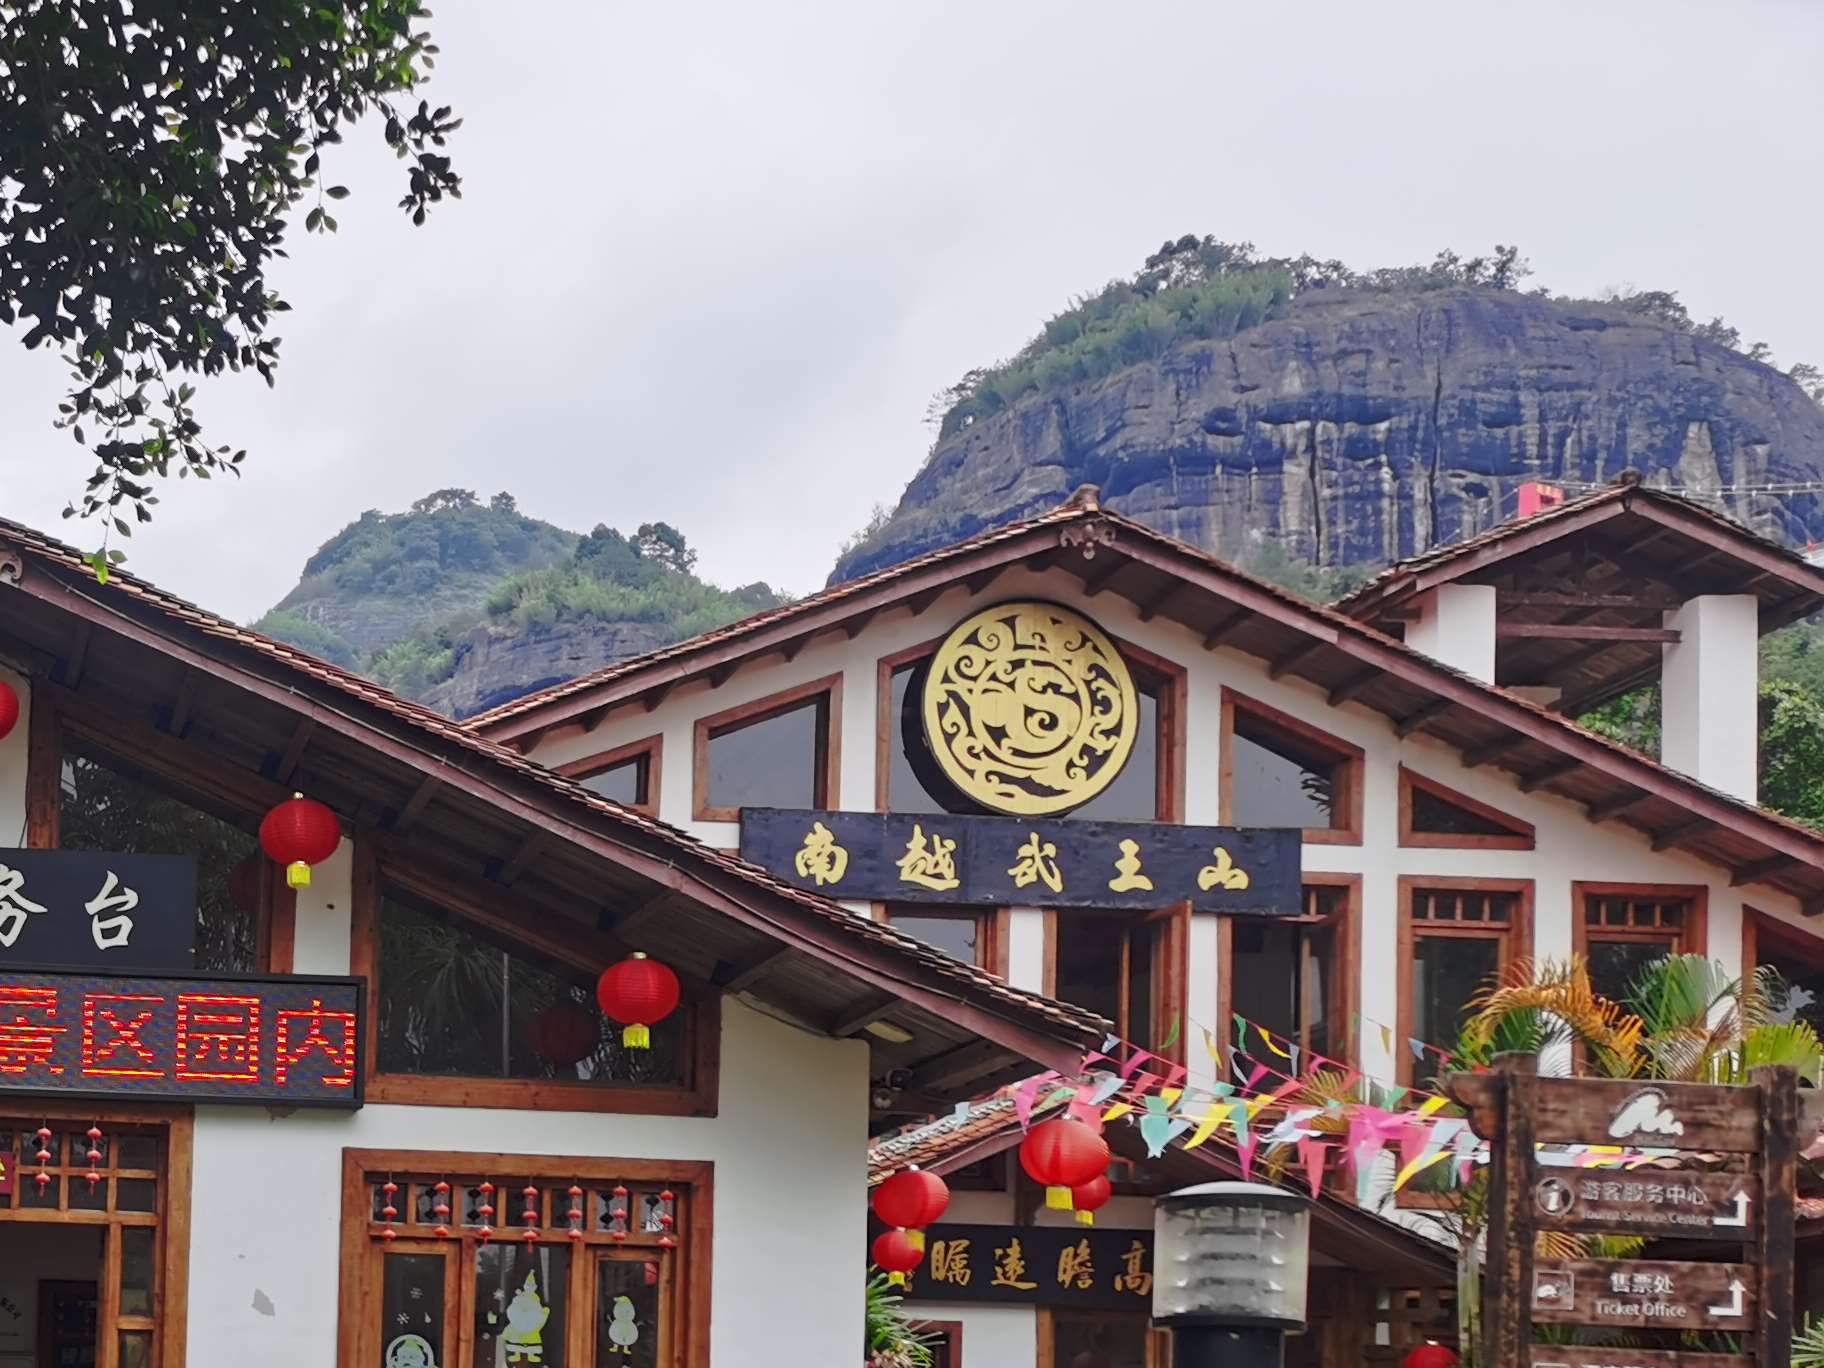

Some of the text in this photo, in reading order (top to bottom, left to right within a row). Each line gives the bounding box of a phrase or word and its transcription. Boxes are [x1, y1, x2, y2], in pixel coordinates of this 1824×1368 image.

[794, 821, 1250, 893] 南越武王山
[1580, 1180, 1708, 1206] 游客服务中心
[1622, 1210, 1667, 1223] Service
[1669, 1212, 1710, 1226] Center
[1610, 1272, 1675, 1294] 售票处
[1595, 1300, 1687, 1318] Ticket Office
